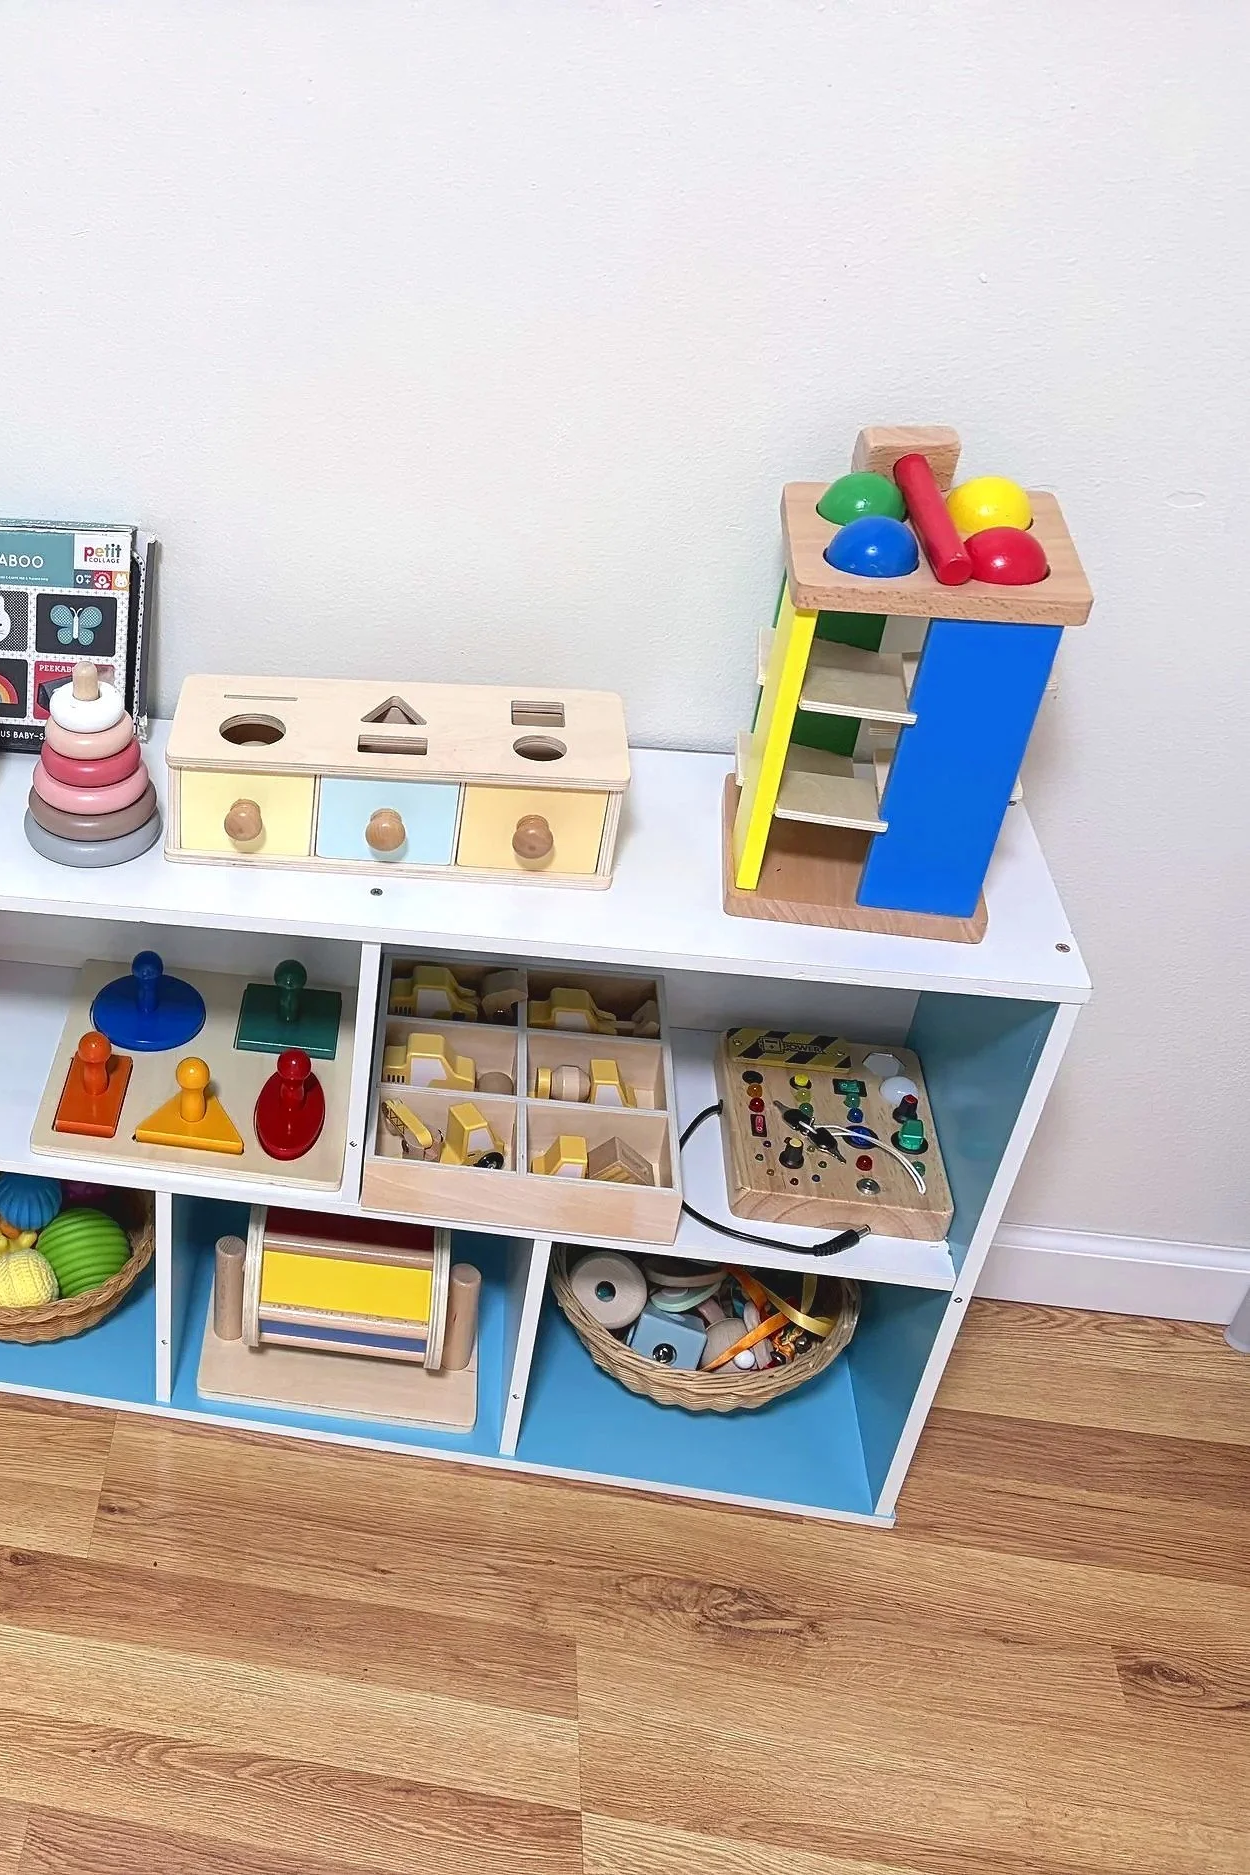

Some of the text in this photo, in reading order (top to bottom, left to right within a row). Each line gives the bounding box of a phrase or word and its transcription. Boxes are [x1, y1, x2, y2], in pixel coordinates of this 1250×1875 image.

[84, 543, 122, 562] petit
[38, 664, 75, 673] PEEKAB
[13, 731, 47, 741] BABY-S
[784, 1042, 824, 1055] POWER
